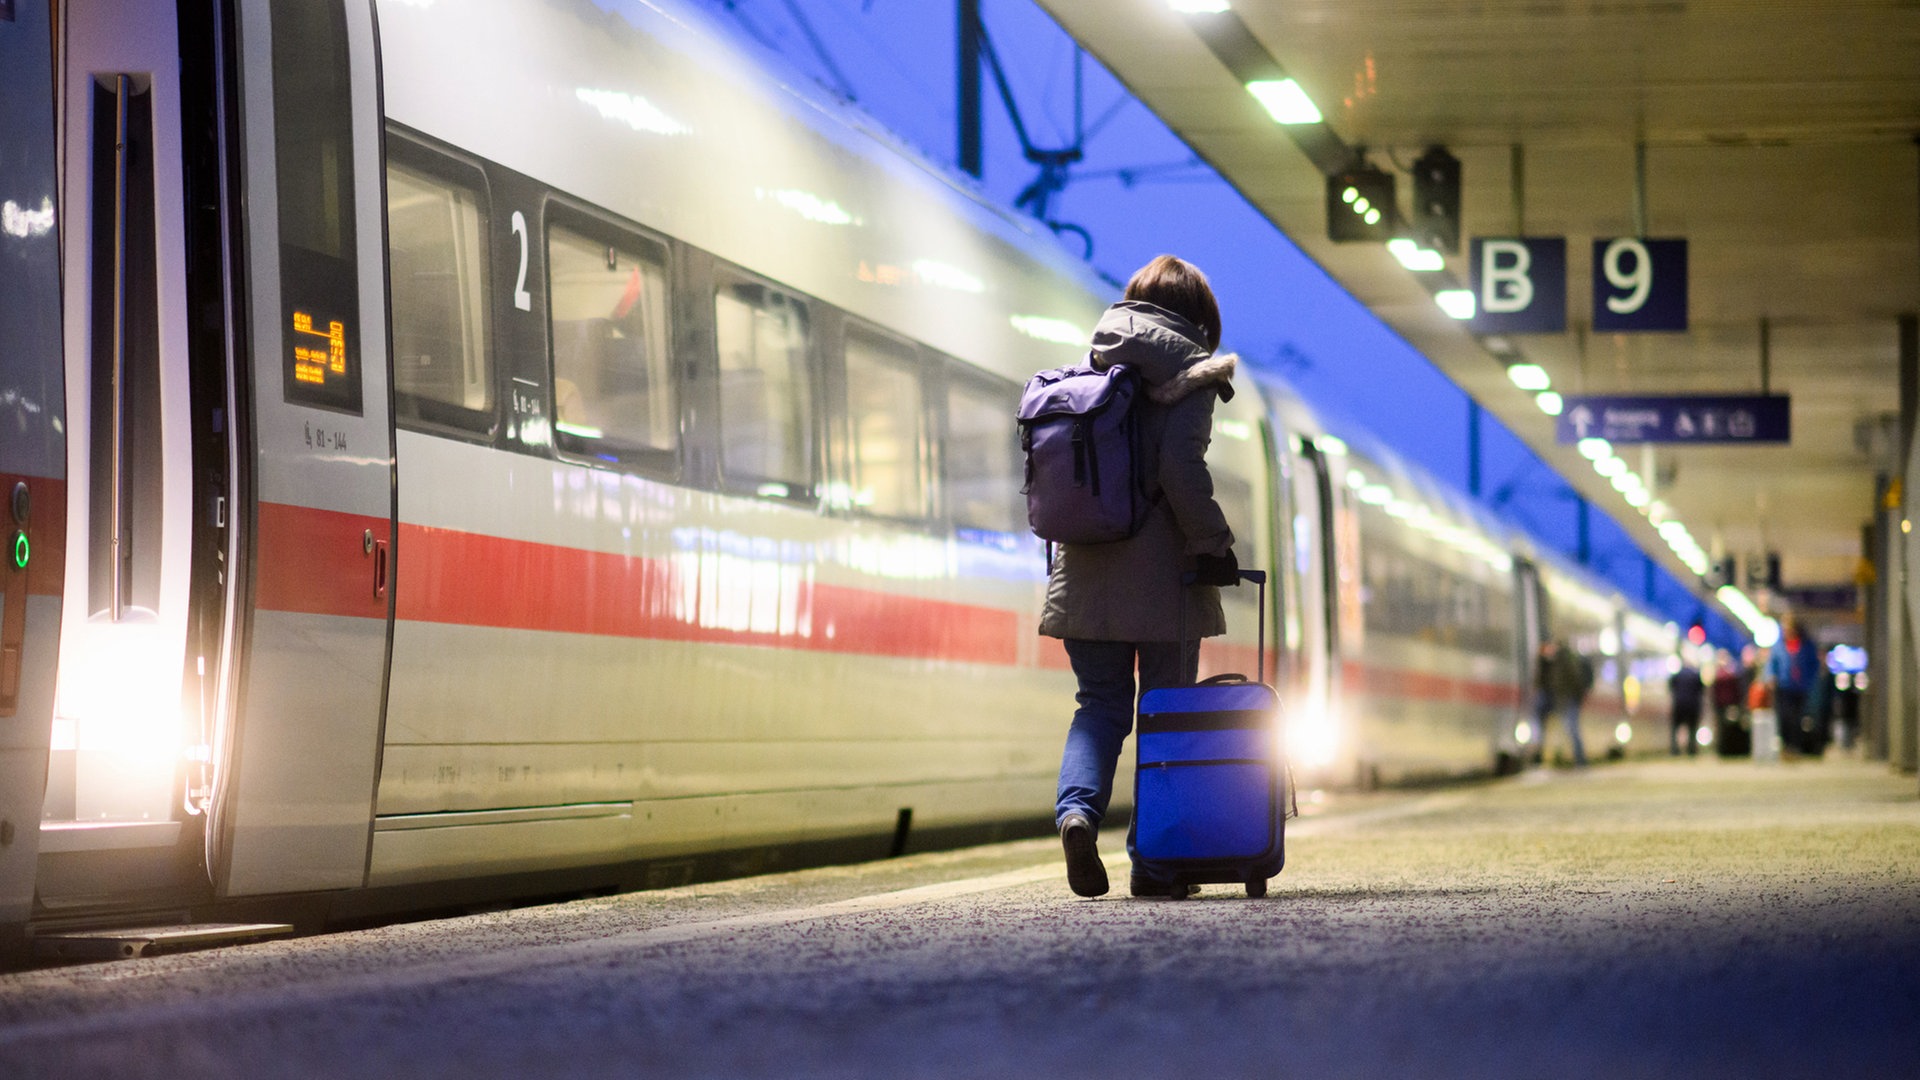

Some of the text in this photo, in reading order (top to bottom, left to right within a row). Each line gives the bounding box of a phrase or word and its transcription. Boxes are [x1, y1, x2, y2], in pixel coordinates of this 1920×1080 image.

[511, 210, 531, 312] 2
[1482, 240, 1534, 313] B
[1603, 238, 1652, 314] 9
[316, 428, 326, 448] 81
[334, 431, 347, 450] 144
